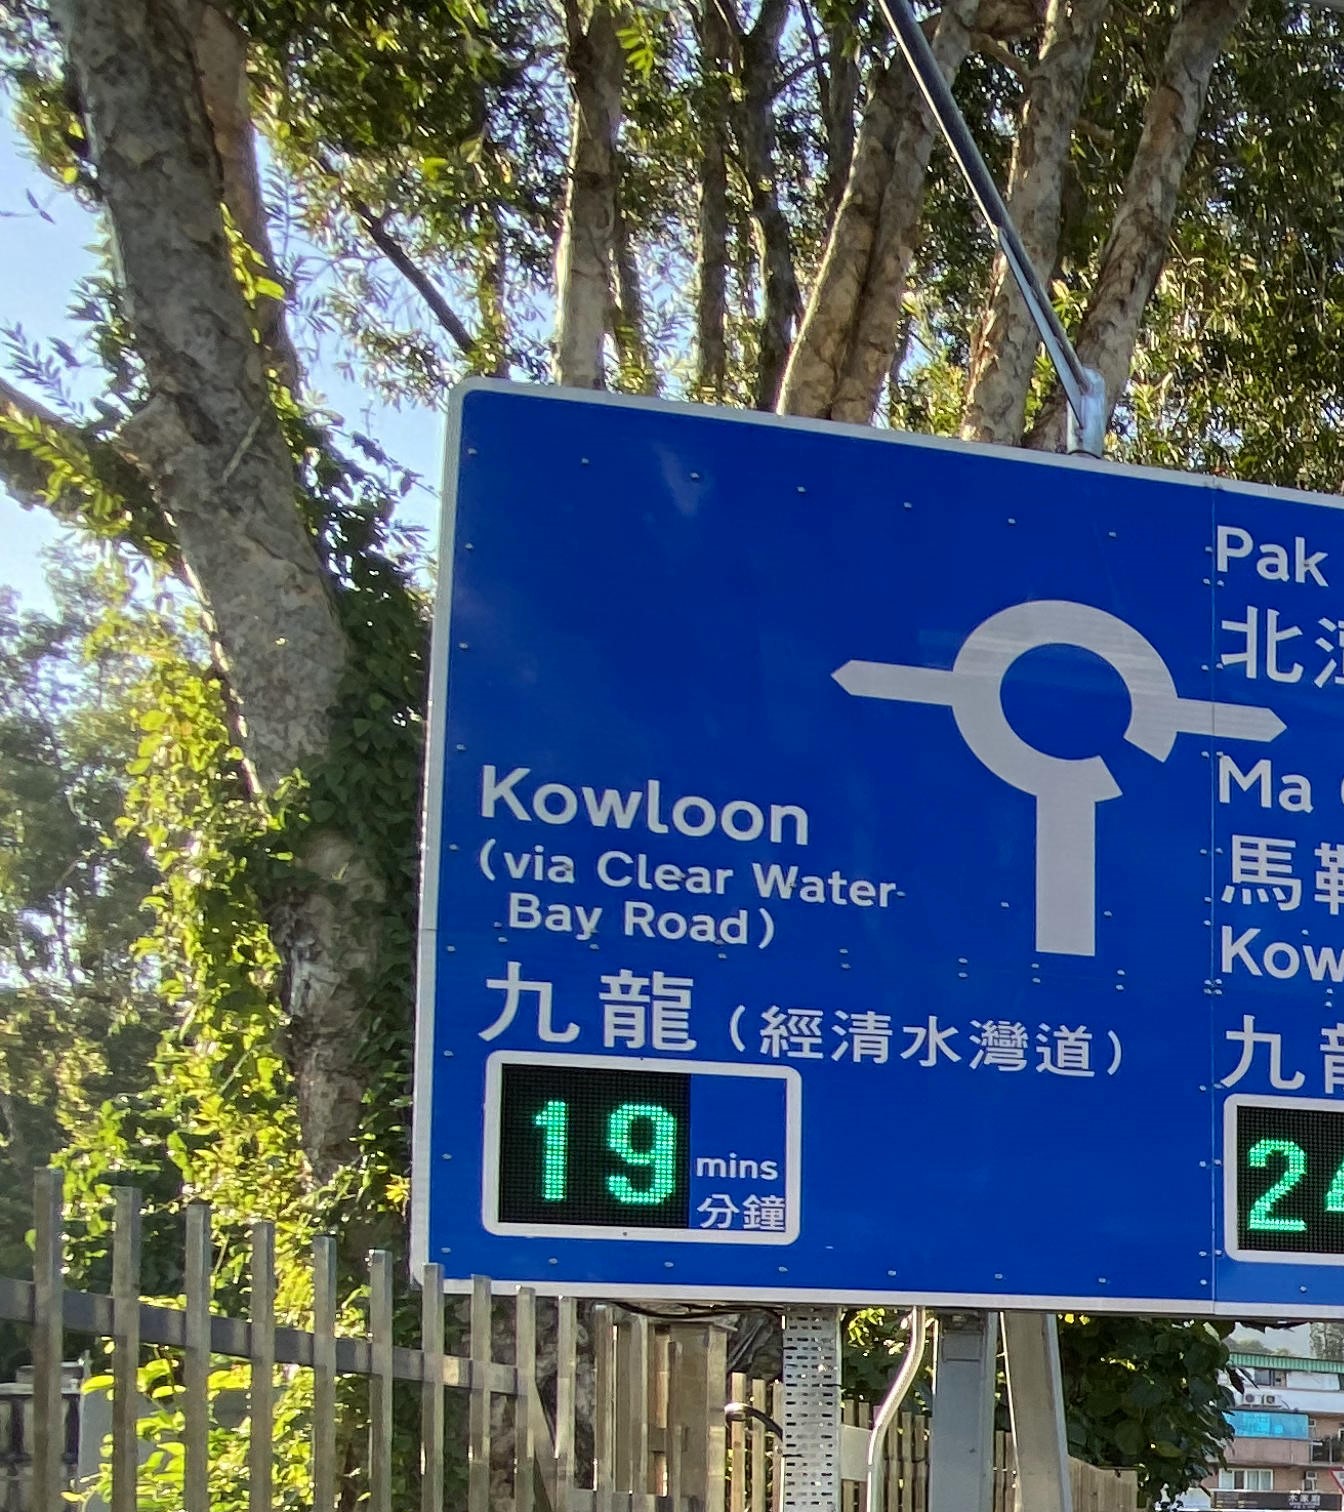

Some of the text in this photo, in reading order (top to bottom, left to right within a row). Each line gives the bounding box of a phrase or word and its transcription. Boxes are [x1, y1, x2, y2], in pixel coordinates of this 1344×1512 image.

[1216, 526, 1328, 588] Pak
[481, 765, 808, 846] Kowloon
[1219, 755, 1313, 813] Ma
[479, 839, 897, 908] (via Clear Water
[508, 893, 775, 950] Bay Road)
[478, 962, 697, 1052] 九龍
[533, 1100, 677, 1206] 19
[696, 1152, 778, 1181] mins
[696, 1193, 786, 1233] 分鐘
